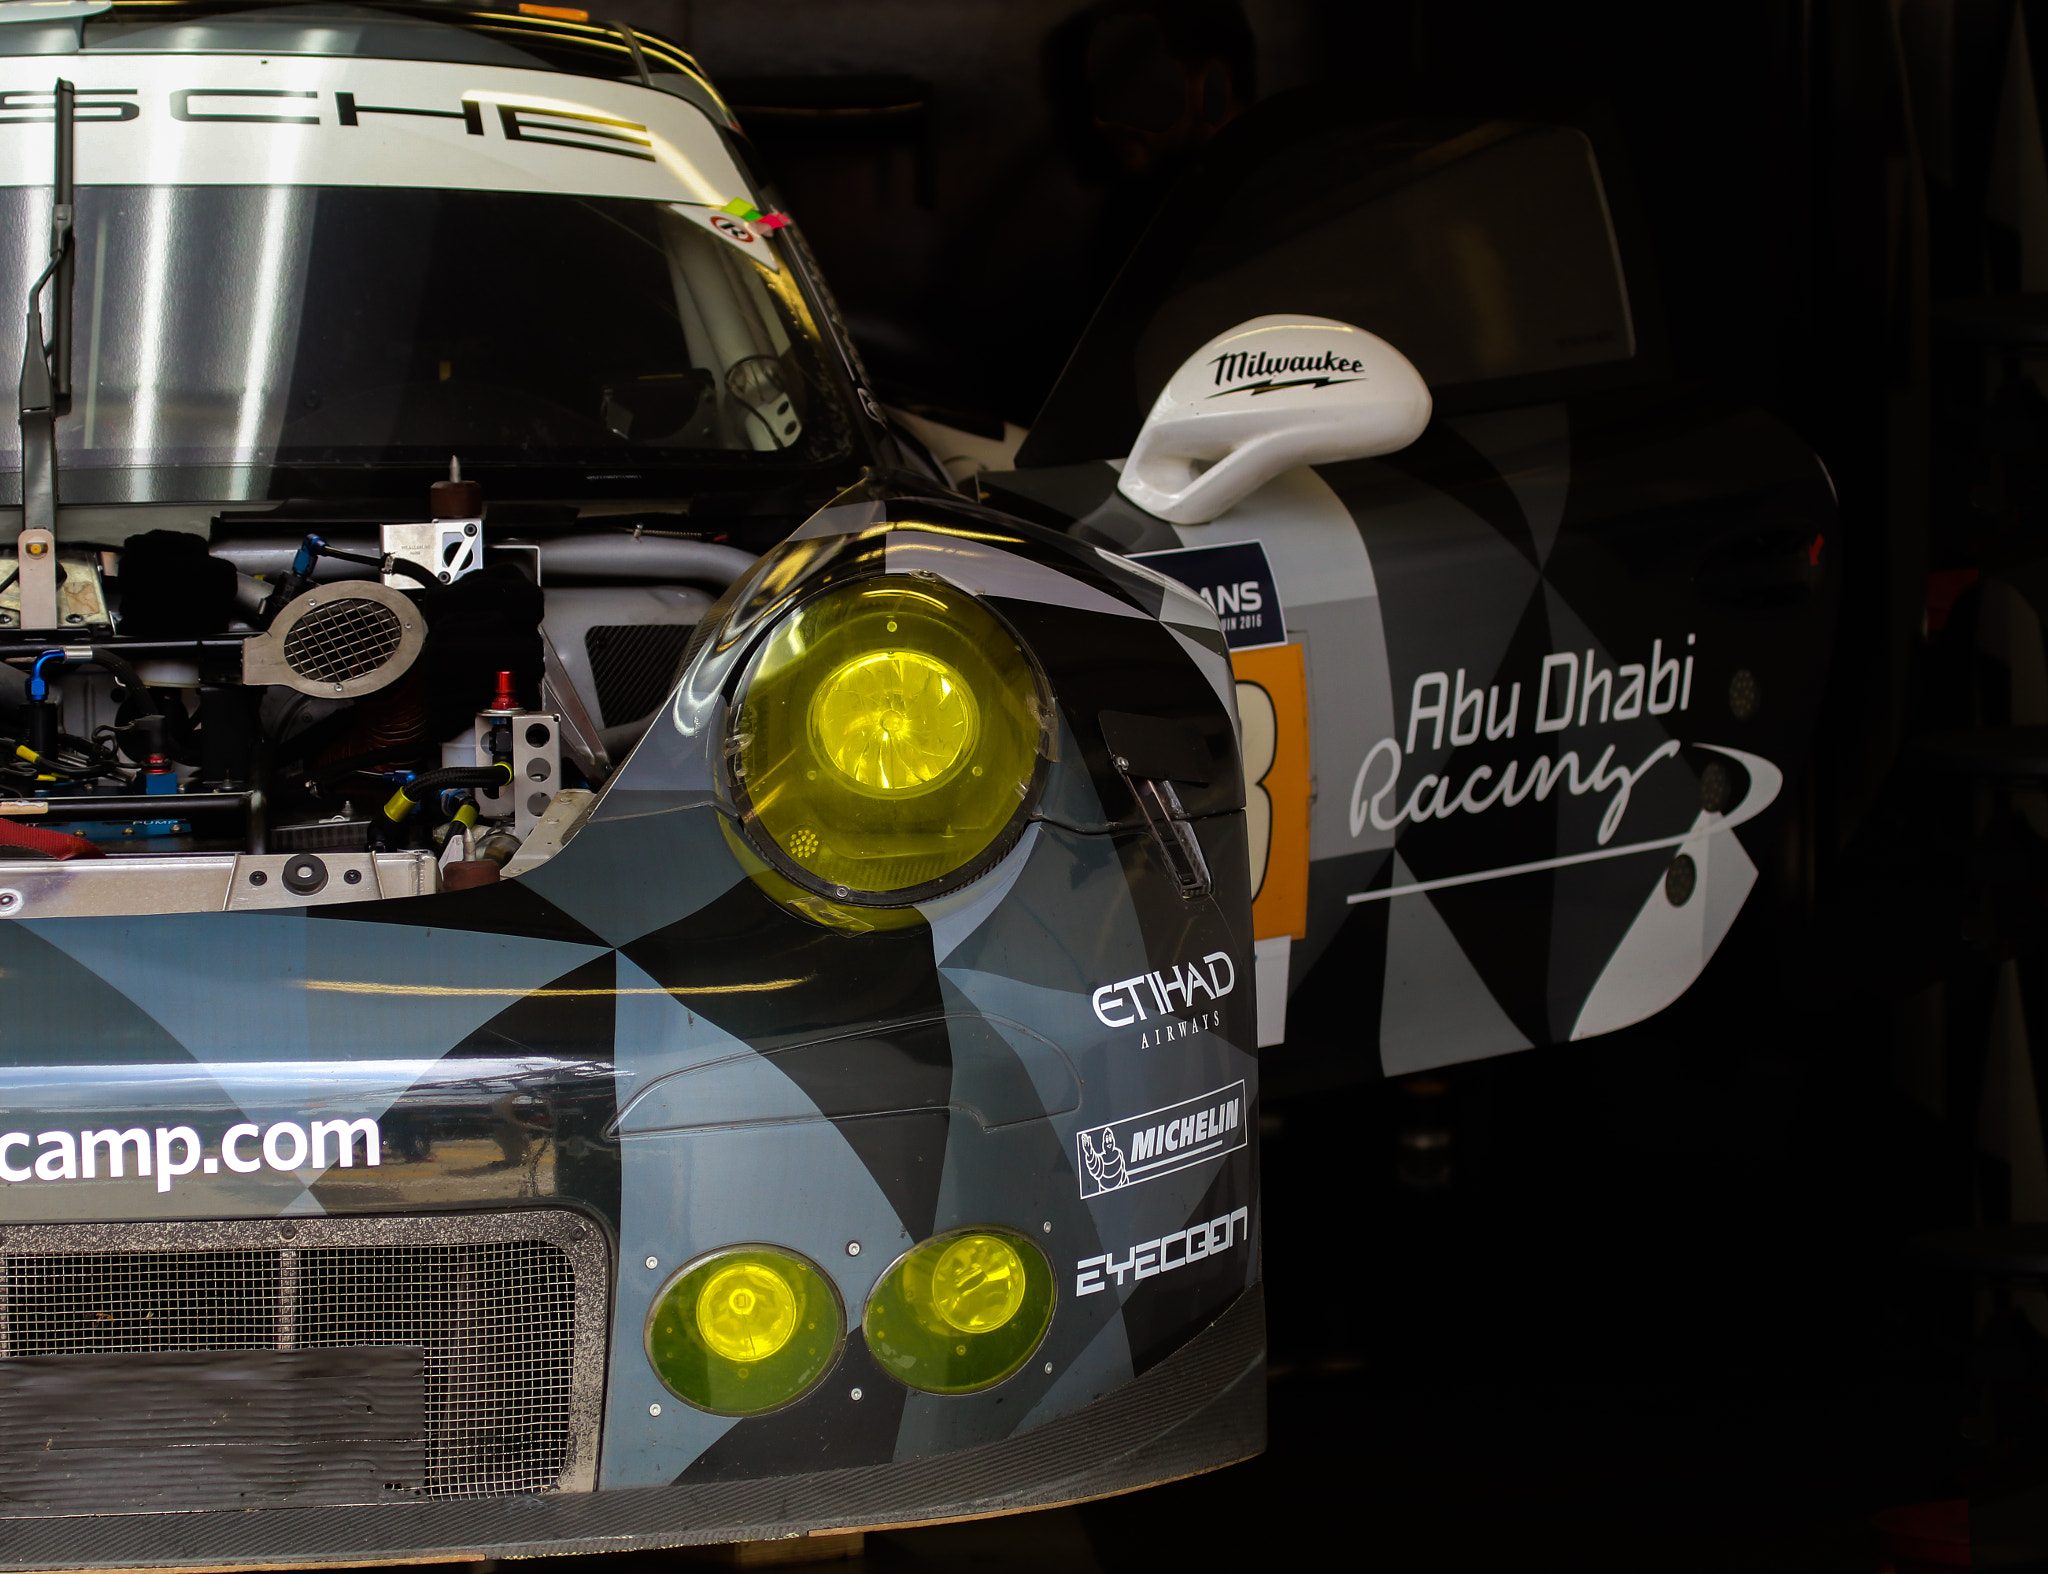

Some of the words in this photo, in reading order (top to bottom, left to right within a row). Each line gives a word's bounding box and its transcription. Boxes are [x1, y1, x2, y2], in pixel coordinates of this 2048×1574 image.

[1206, 350, 1365, 386] Milwaukee
[1240, 614, 1262, 629] 2016
[1406, 668, 1521, 754] Abu
[1535, 633, 1696, 734] Dhabi
[1350, 737, 1681, 846] Racing
[1092, 951, 1235, 1028] ETIHAD
[1141, 1010, 1220, 1049] AIRWAYS
[0, 1117, 381, 1193] camp.com
[1130, 1097, 1239, 1163] MICHELIN
